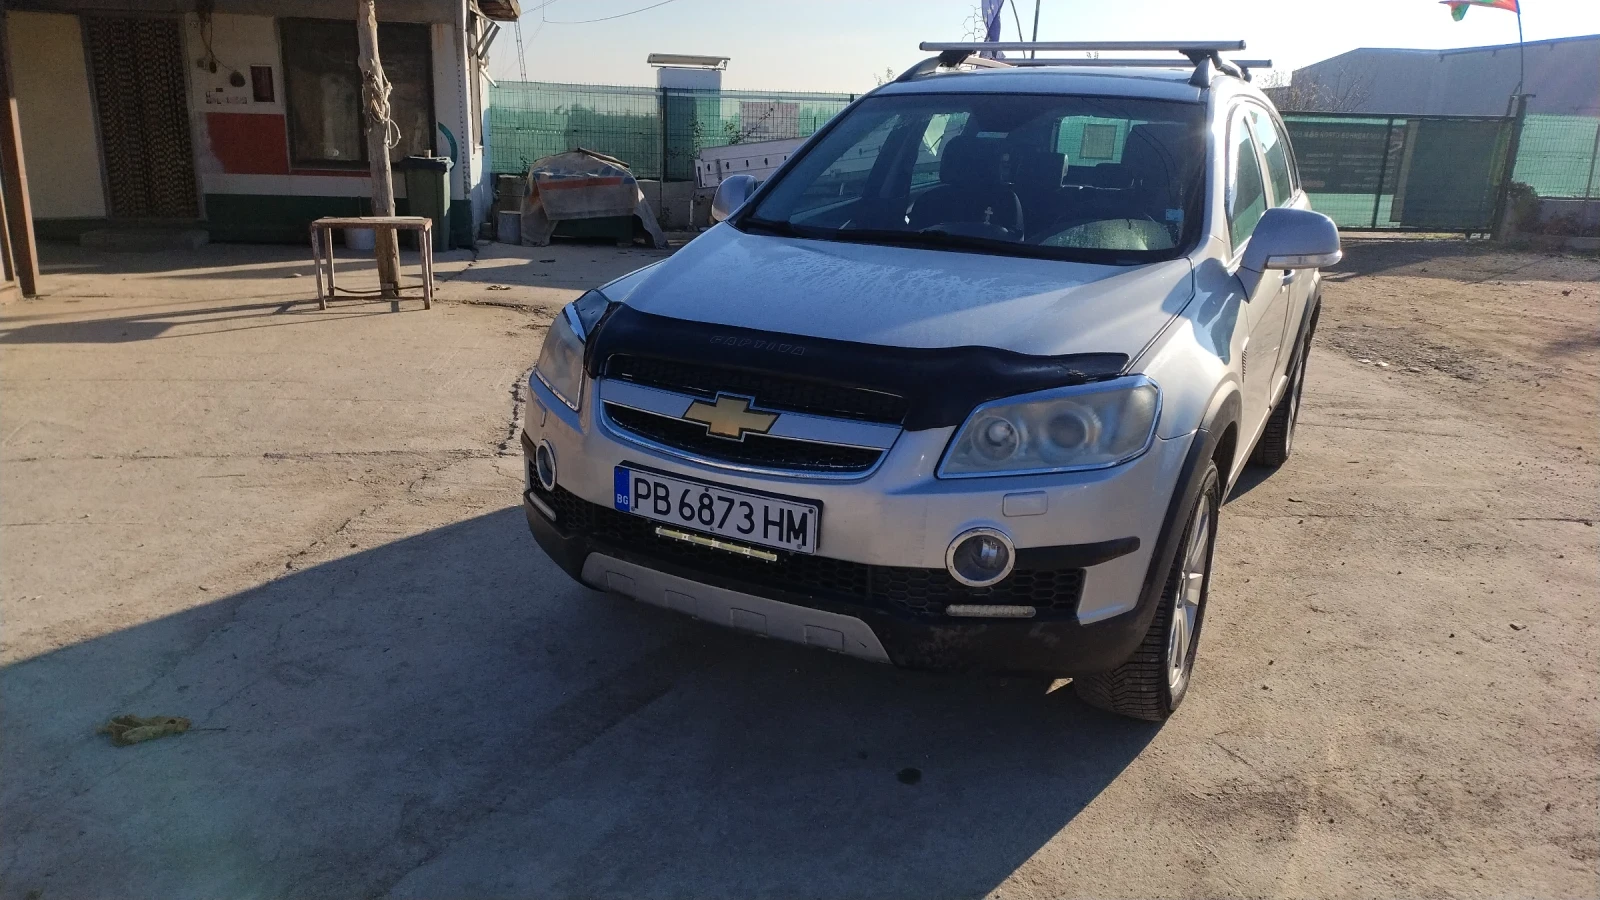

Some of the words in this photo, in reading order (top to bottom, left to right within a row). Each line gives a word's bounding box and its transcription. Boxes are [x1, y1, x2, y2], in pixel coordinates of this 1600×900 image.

[709, 335, 806, 356] CAPTIVA
[616, 493, 629, 505] BG
[634, 477, 671, 516] PB
[678, 488, 755, 534] 6873
[763, 505, 808, 547] HM
